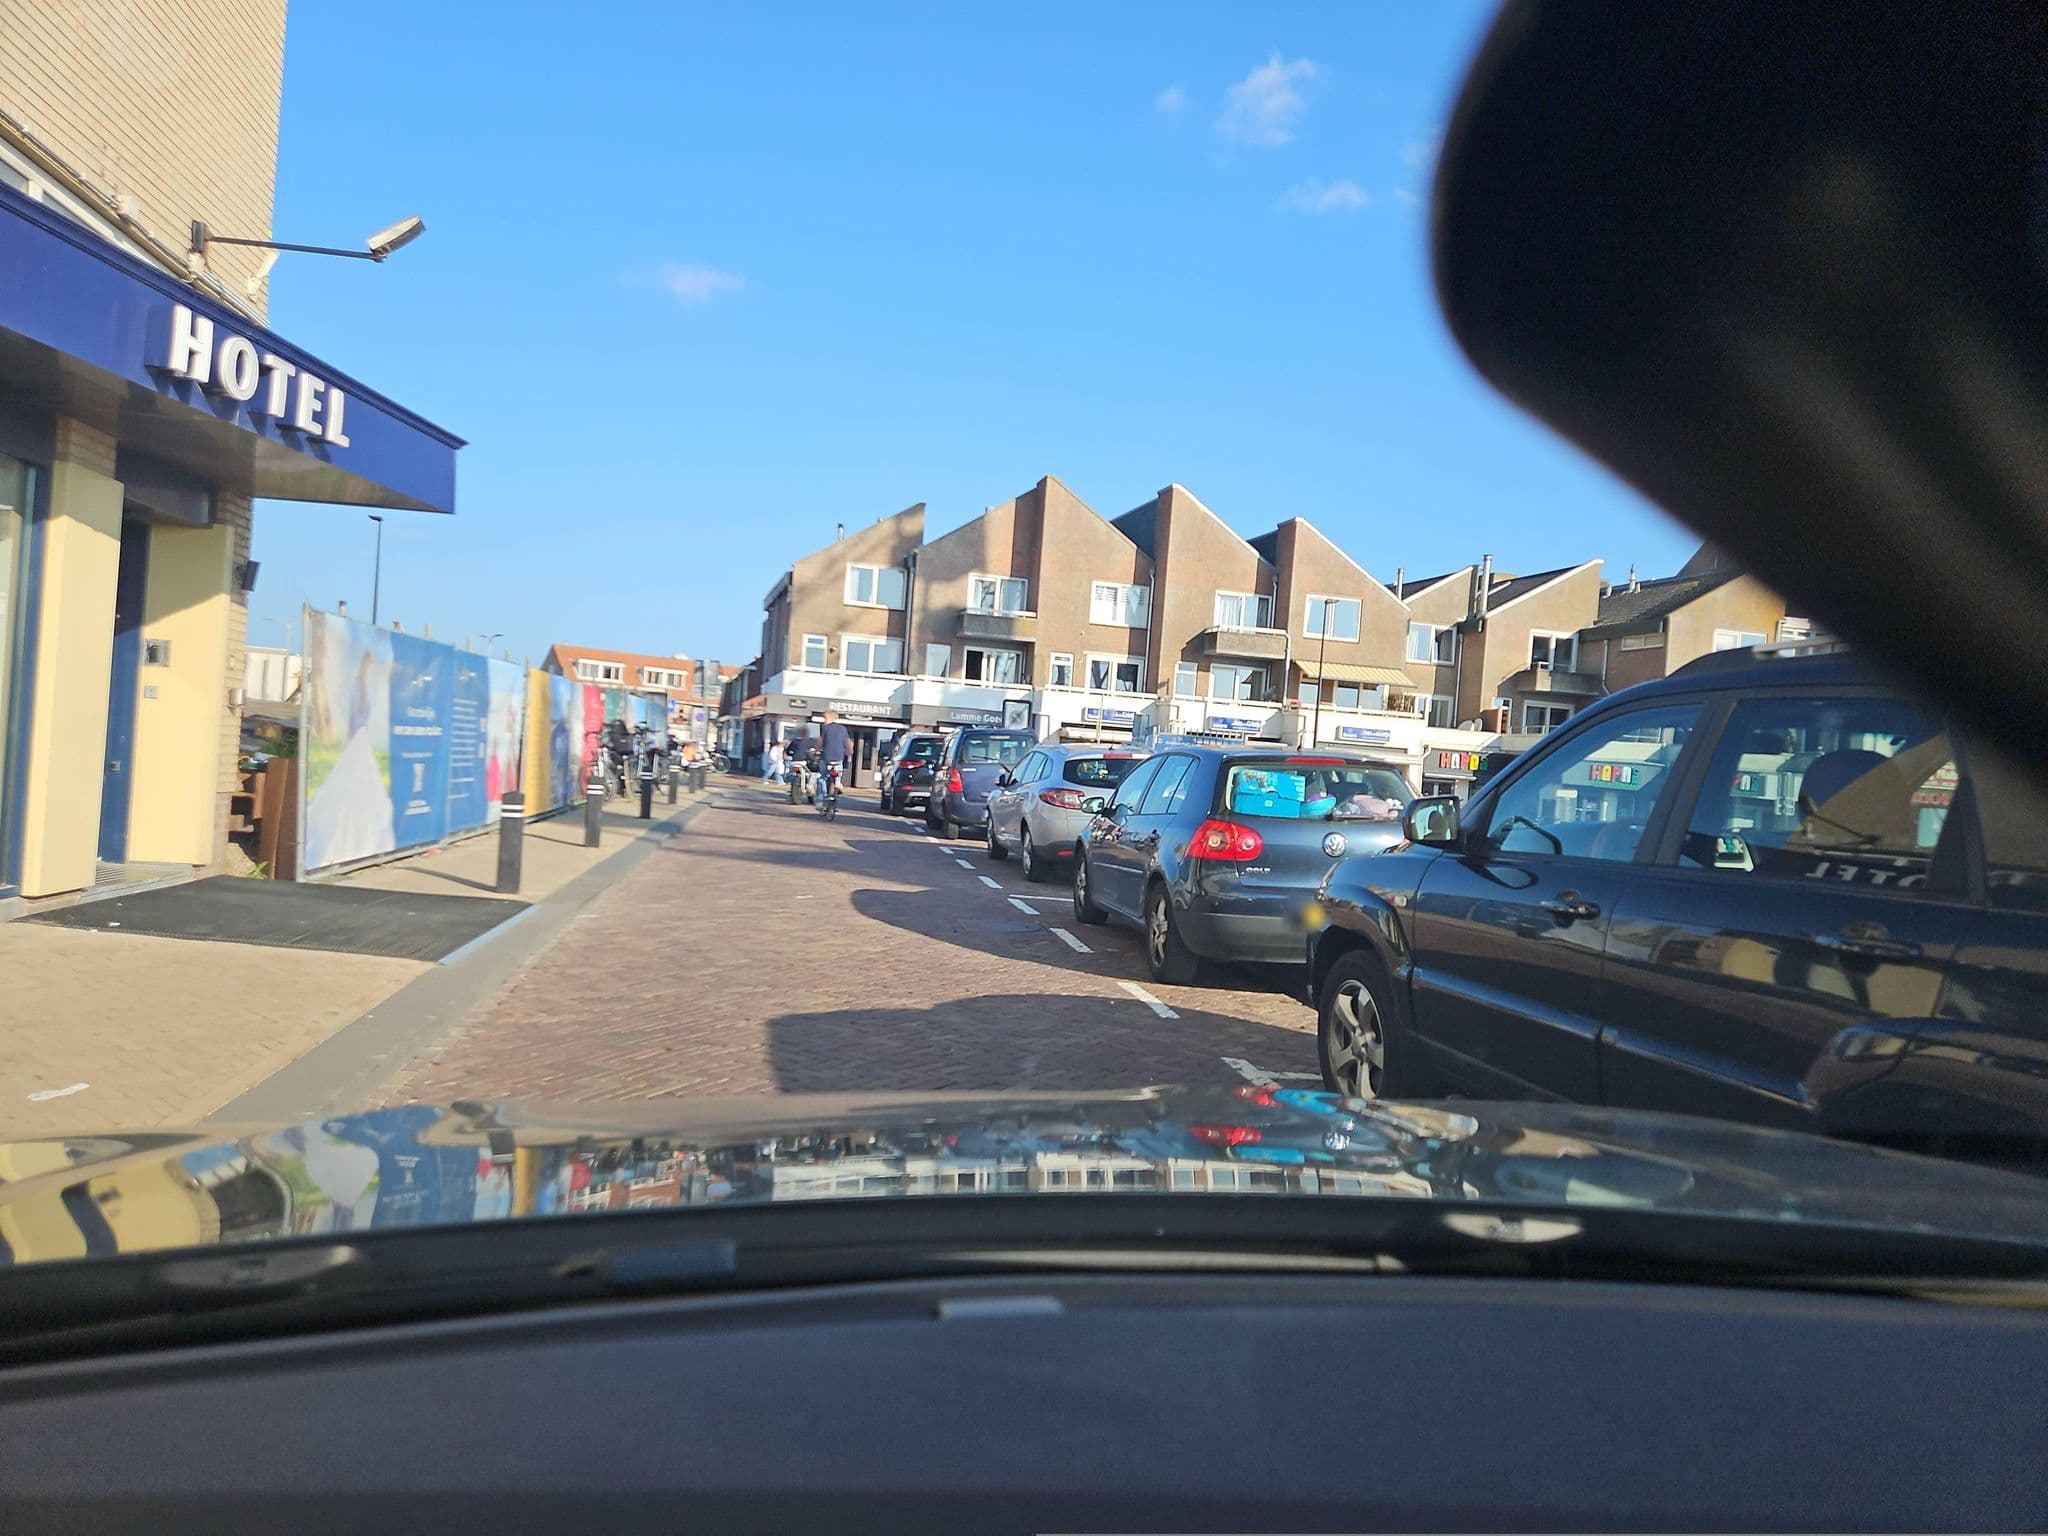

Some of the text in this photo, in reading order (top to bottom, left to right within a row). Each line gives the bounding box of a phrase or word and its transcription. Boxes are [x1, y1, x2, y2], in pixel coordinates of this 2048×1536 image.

[167, 303, 350, 448] HOTEL
[829, 701, 893, 715] RESTAURANT
[951, 711, 1003, 723] Lamme Goe
